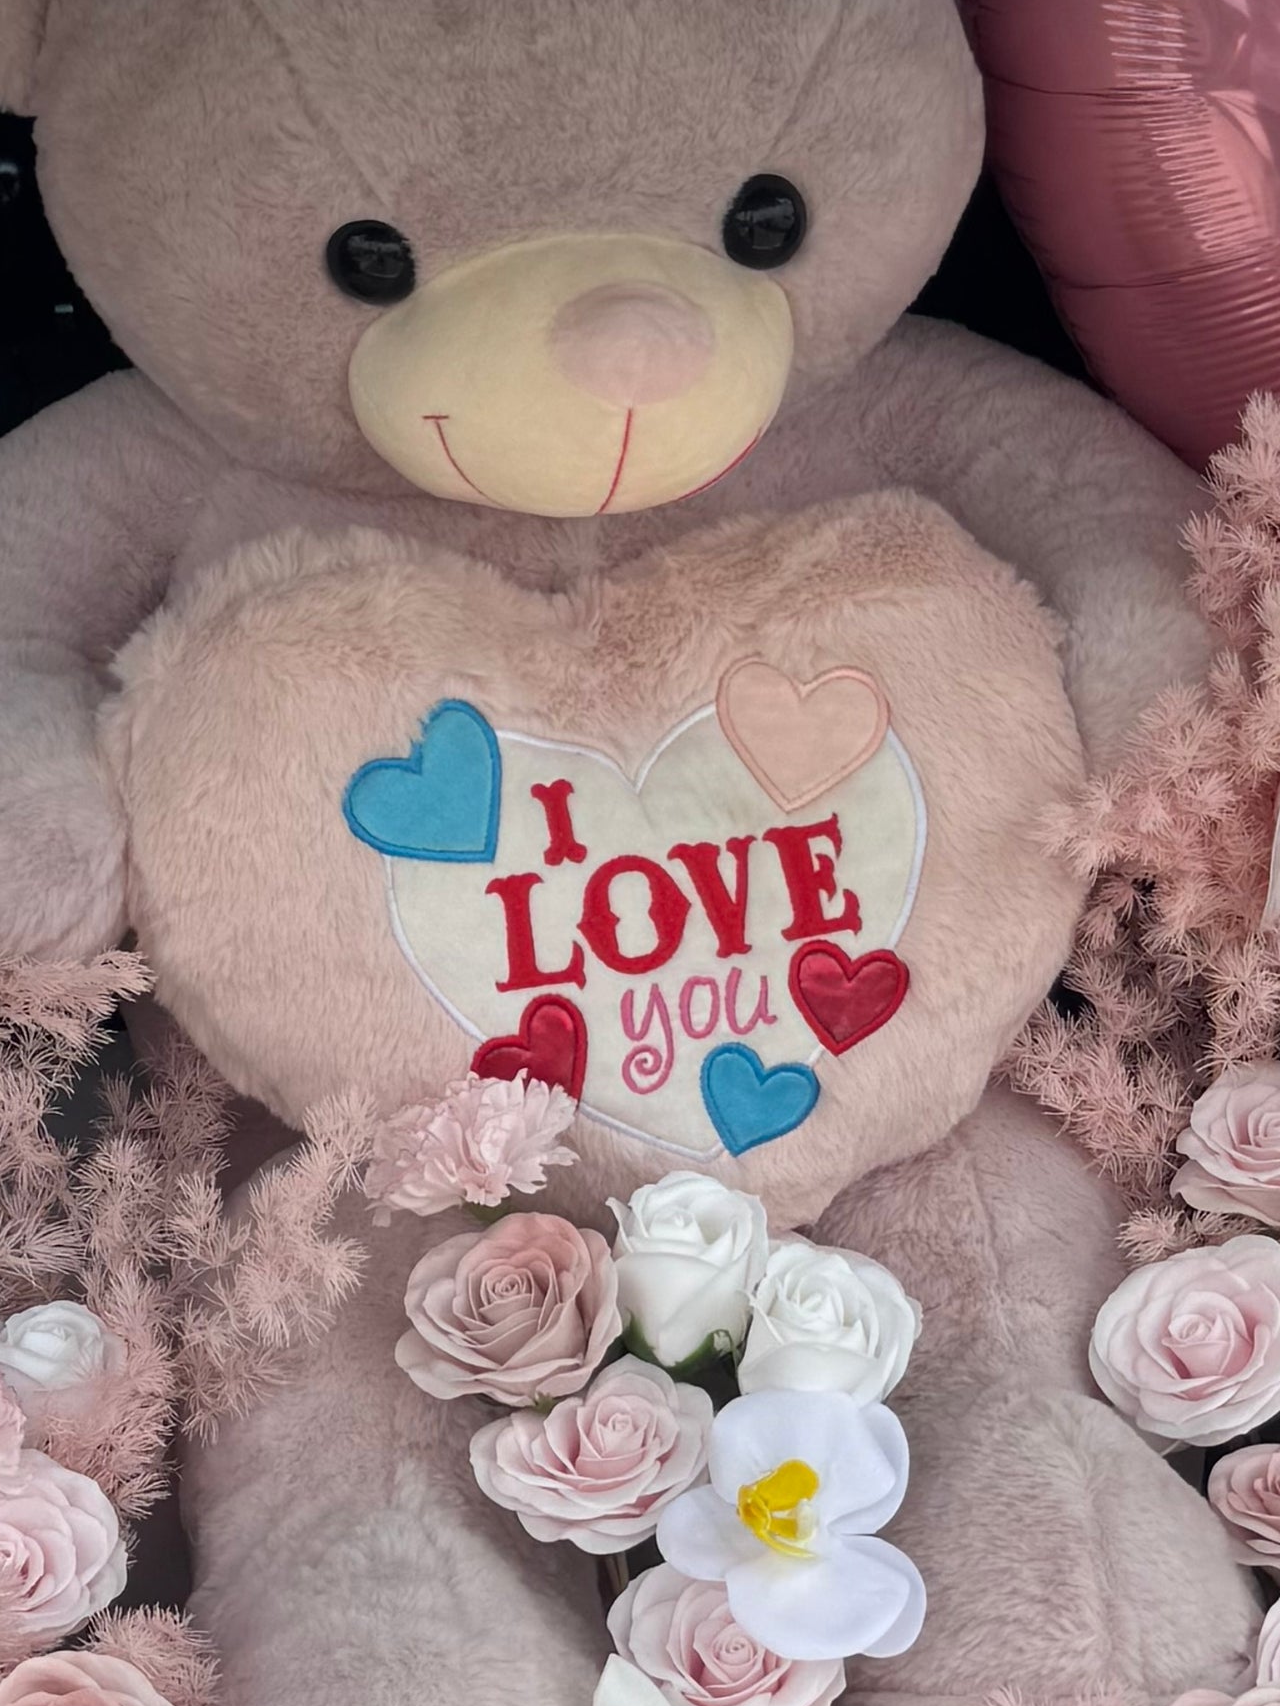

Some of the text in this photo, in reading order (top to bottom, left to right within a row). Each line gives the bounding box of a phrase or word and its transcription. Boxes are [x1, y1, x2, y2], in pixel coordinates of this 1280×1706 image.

[530, 778, 588, 867] I
[485, 812, 863, 993] LOVE
[620, 966, 777, 1095] you
